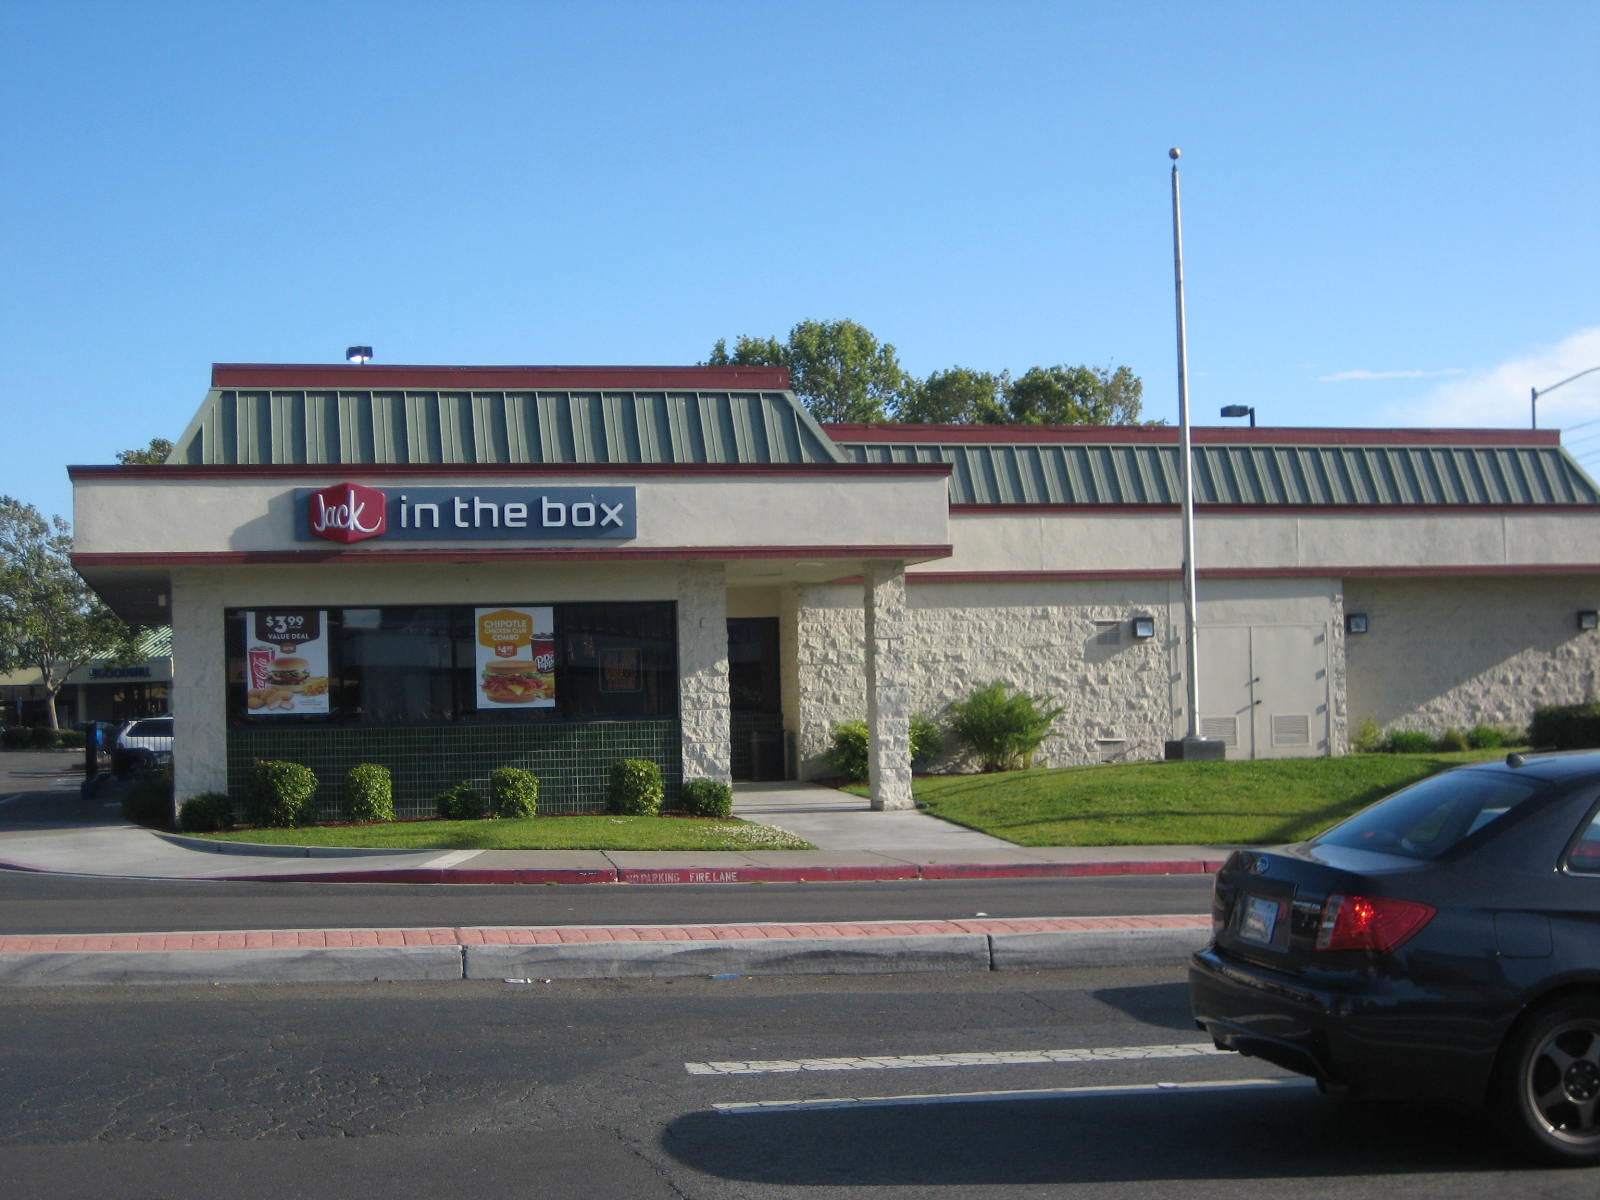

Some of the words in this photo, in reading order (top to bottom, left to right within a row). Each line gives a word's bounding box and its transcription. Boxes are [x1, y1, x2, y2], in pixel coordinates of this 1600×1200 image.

[314, 489, 382, 533] Jack
[400, 495, 439, 528] in
[454, 496, 528, 528] the
[541, 496, 624, 528] box
[485, 620, 527, 628] CHIPOTLE
[626, 873, 640, 883] NO
[641, 873, 680, 882] PARKING
[689, 872, 711, 882] FIRE
[712, 872, 738, 882] LANE
